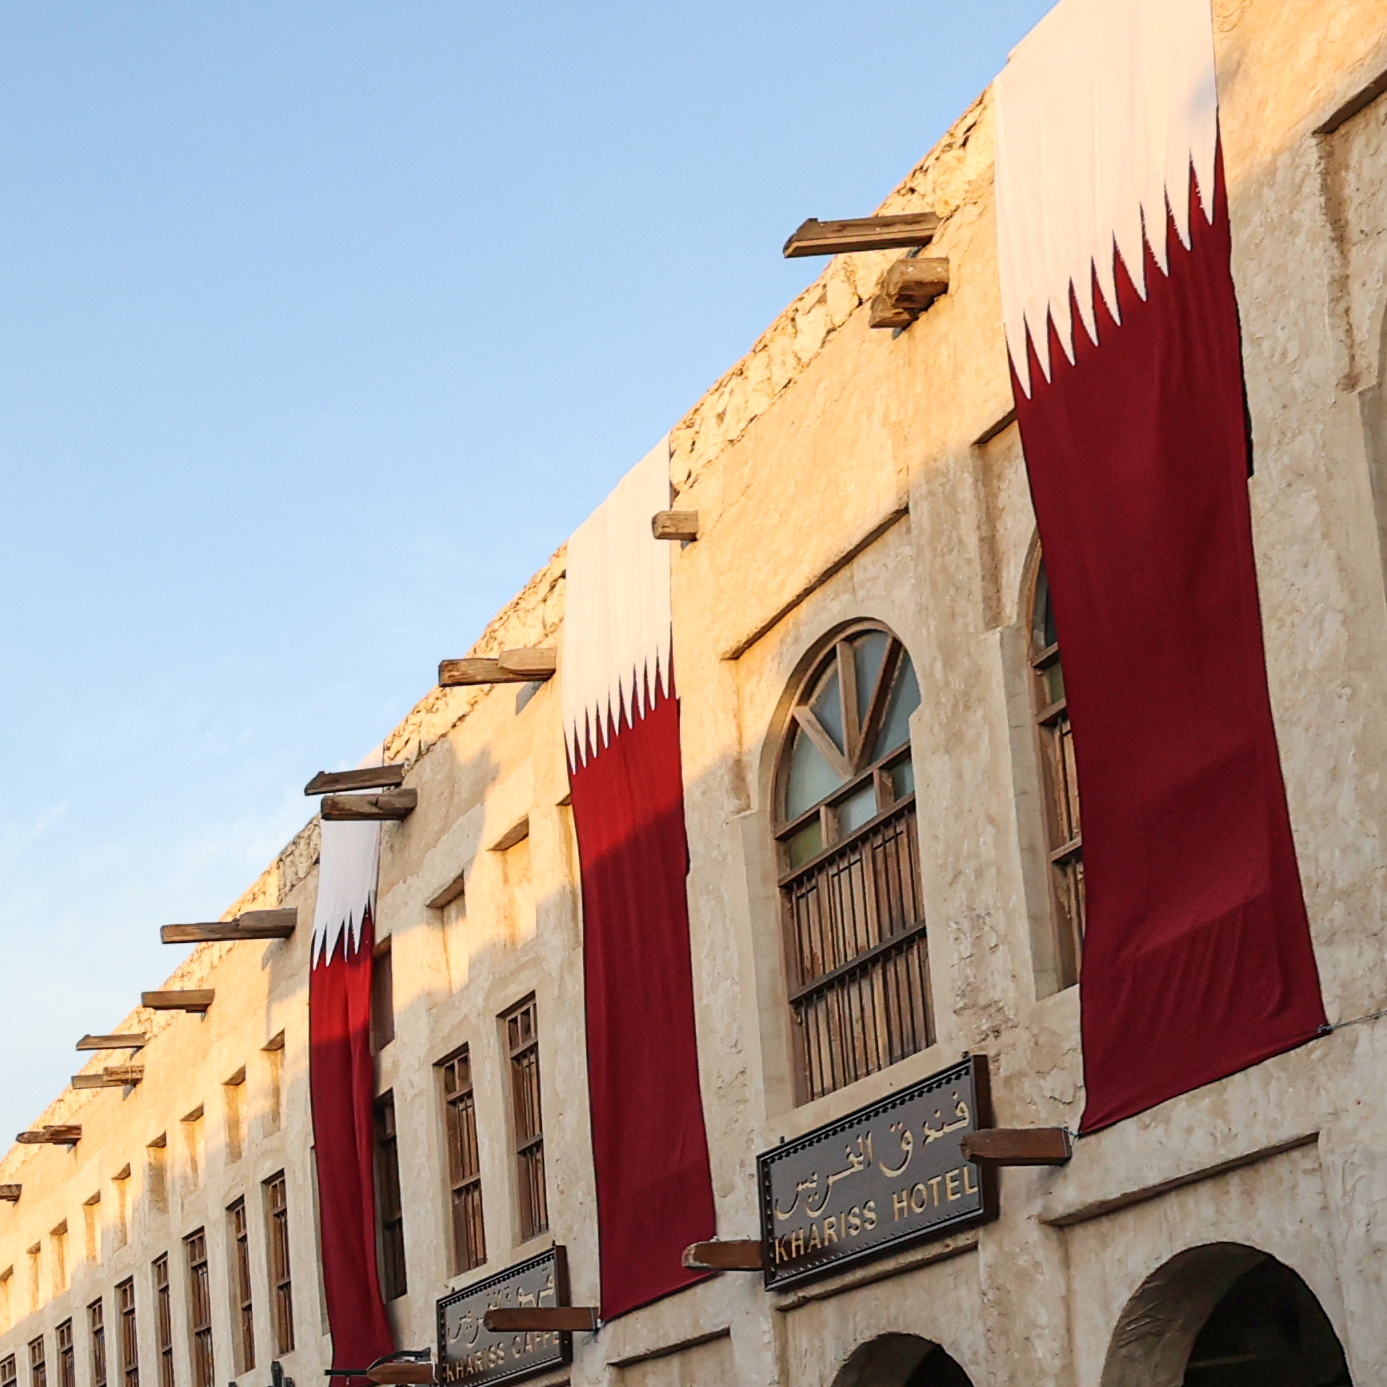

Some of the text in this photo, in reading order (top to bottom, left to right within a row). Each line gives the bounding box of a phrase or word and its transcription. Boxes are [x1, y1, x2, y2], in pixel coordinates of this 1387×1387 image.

[775, 1091, 970, 1221] فندق الخريس
[775, 1165, 978, 1264] KHARISS HOTEL
[446, 1342, 505, 1383] KHARISS
